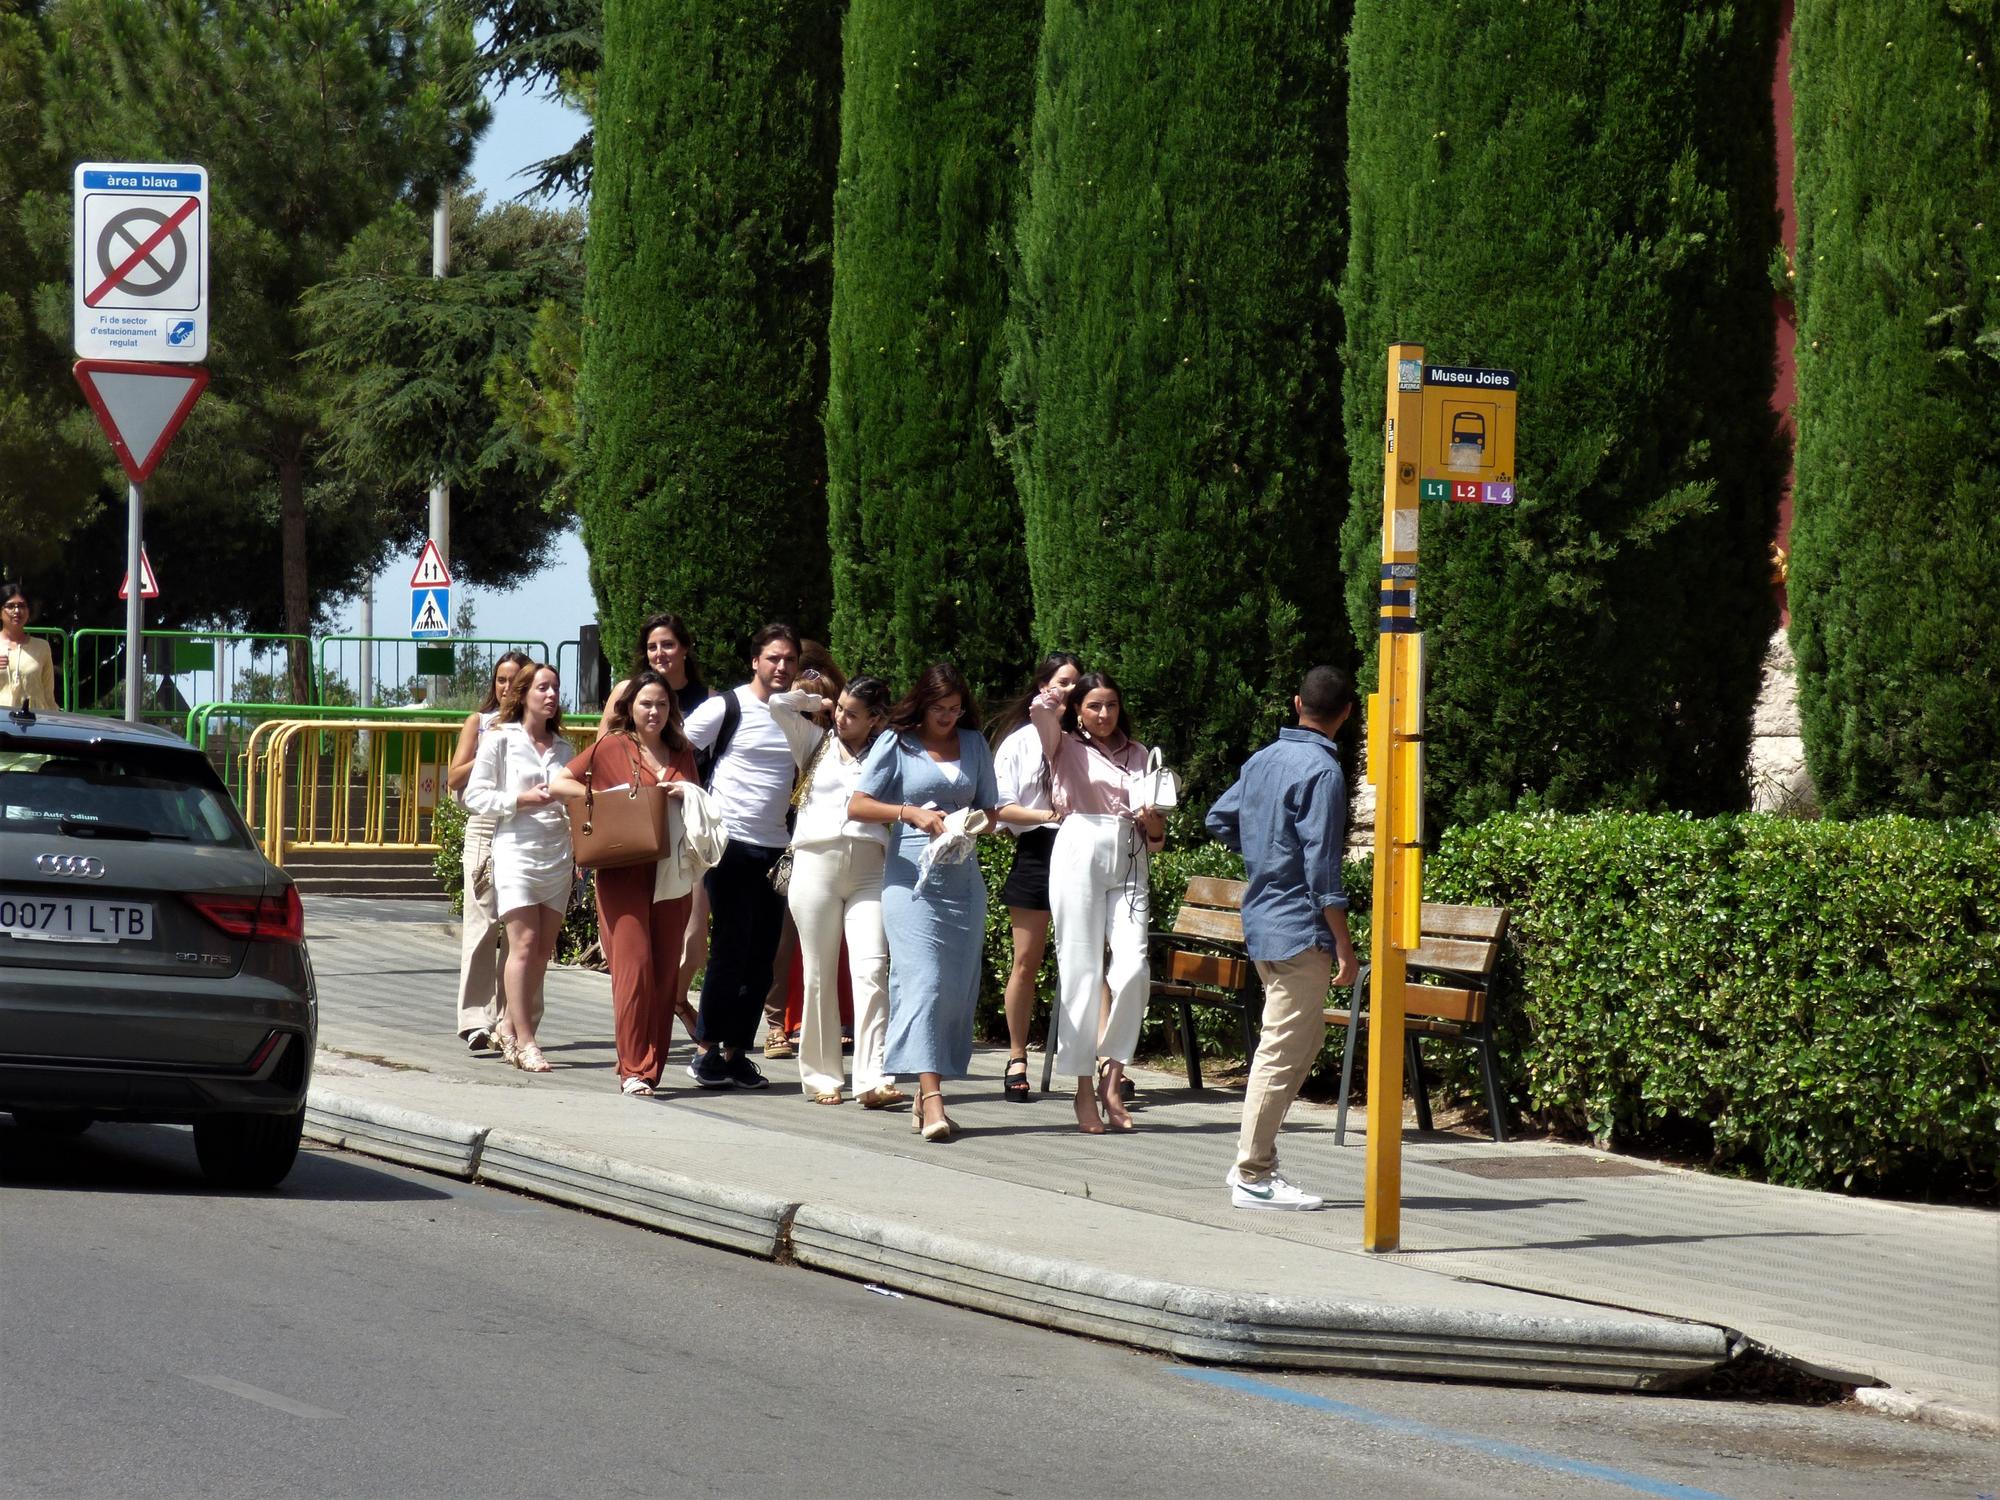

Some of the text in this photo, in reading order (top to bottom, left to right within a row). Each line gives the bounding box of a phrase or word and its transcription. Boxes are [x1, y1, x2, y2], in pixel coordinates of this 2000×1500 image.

[107, 174, 178, 188] àrea blava
[100, 316, 148, 325] Fi de sector
[90, 327, 157, 336] d'estacionament
[109, 339, 138, 347] regulat
[1431, 369, 1510, 386] Museu Joies
[1428, 483, 1443, 496] L1
[1457, 485, 1476, 498] L2
[43, 811, 99, 821] Autoodium
[0, 901, 144, 935] 0071 LTB
